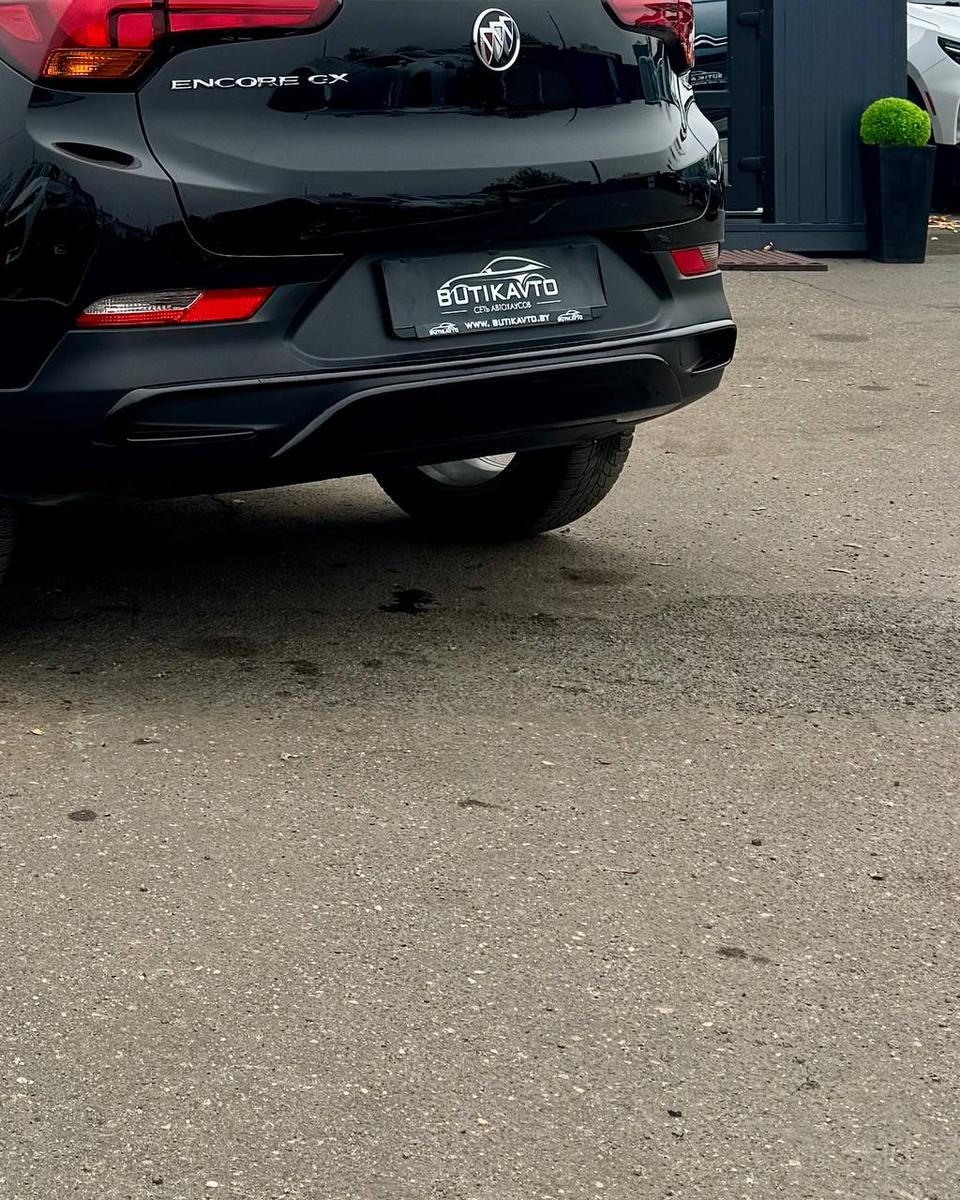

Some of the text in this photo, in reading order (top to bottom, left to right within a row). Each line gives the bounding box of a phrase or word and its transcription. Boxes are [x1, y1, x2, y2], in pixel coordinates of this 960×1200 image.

[171, 73, 349, 90] ENCORE GX
[436, 278, 559, 307] BUTIKAVTO
[473, 305, 491, 314] СЕТЬ
[492, 313, 550, 327] BUTIKAVTO.BY
